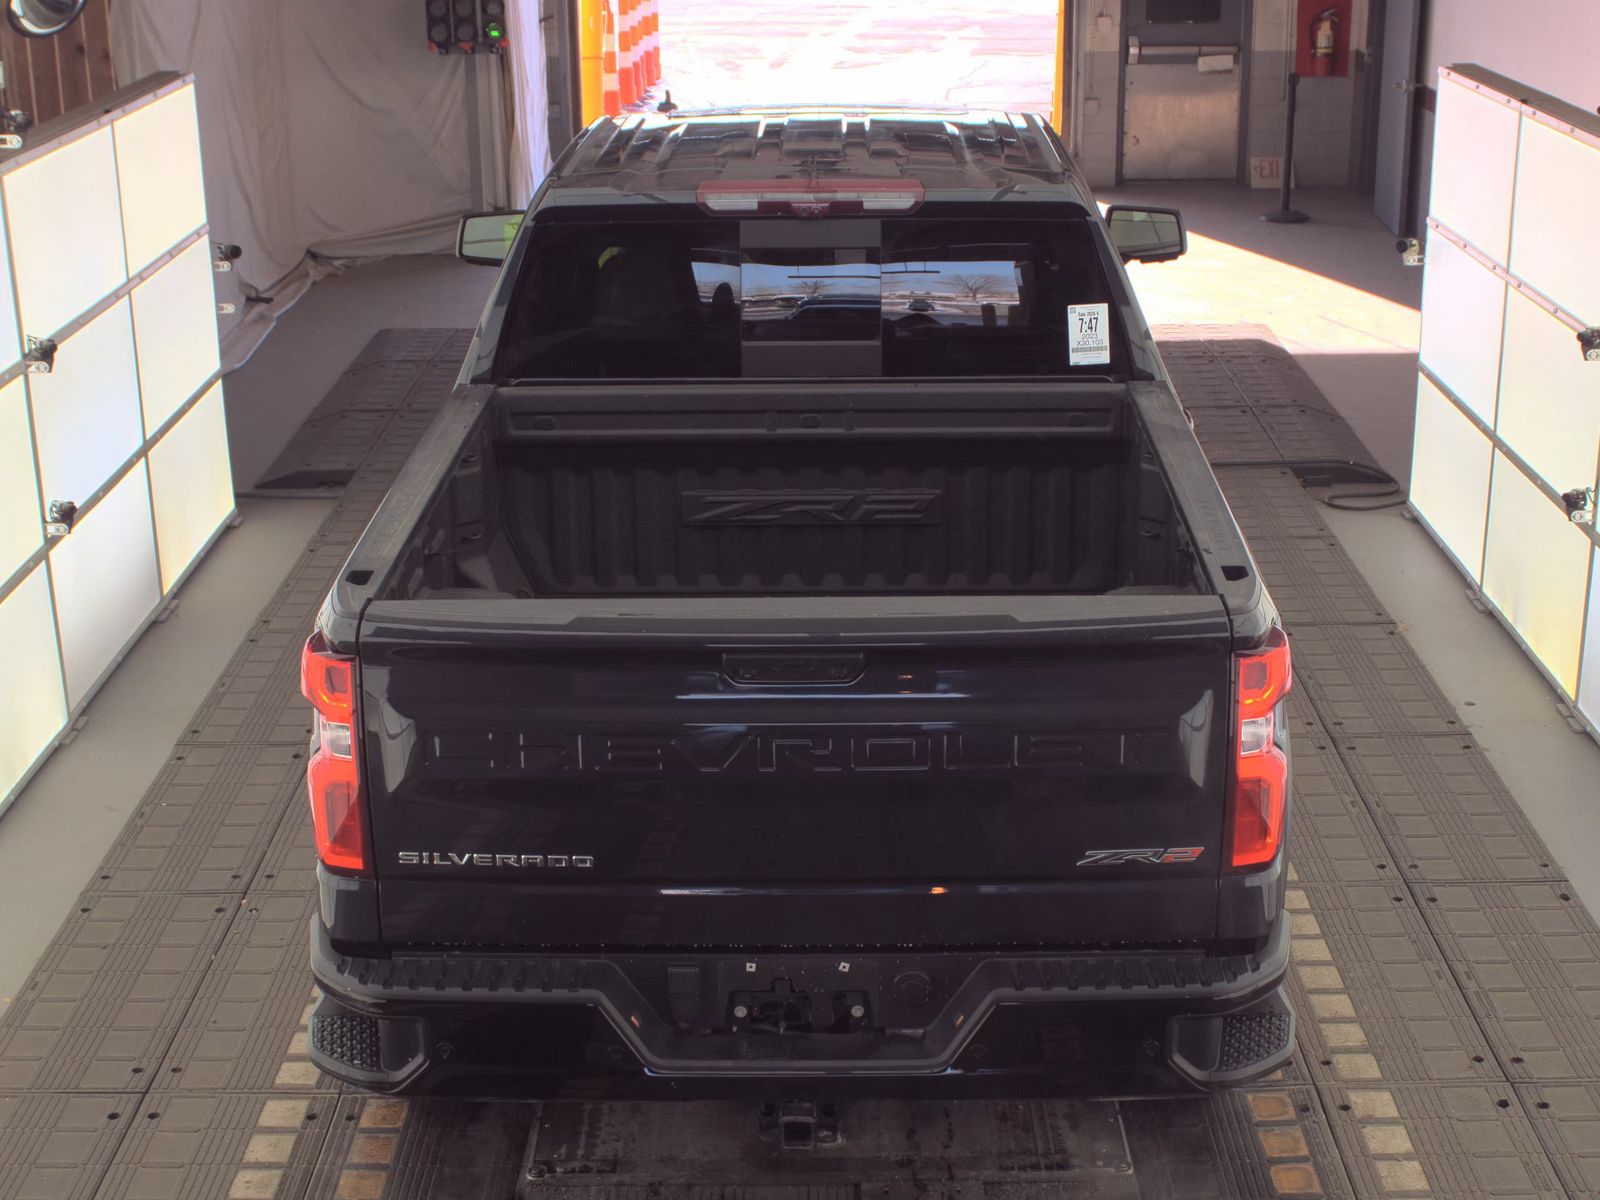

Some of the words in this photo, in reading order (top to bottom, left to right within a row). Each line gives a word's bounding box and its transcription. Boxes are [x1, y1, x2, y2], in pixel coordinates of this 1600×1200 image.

[1078, 317, 1099, 333] 7:47
[423, 728, 1170, 774] CHEVROLET
[398, 851, 594, 868] SILVERADO
[1076, 846, 1205, 866] ZR2
